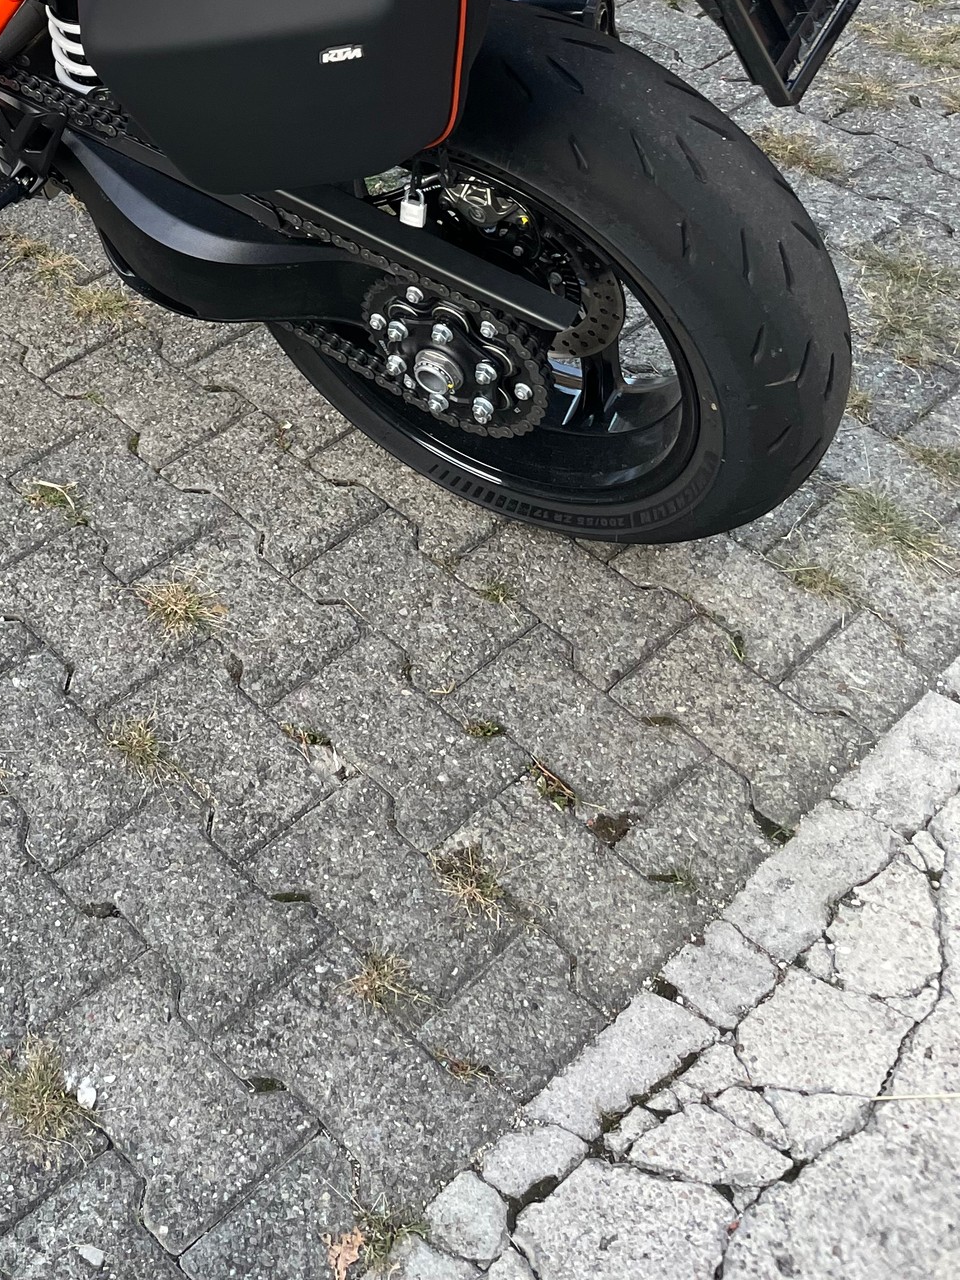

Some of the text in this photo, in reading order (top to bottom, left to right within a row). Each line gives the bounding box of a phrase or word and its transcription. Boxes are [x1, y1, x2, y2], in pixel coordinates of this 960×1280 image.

[322, 47, 362, 63] KTM
[639, 467, 710, 525] MICHELIN
[553, 512, 572, 523] ZR
[576, 517, 625, 528] 200/55
